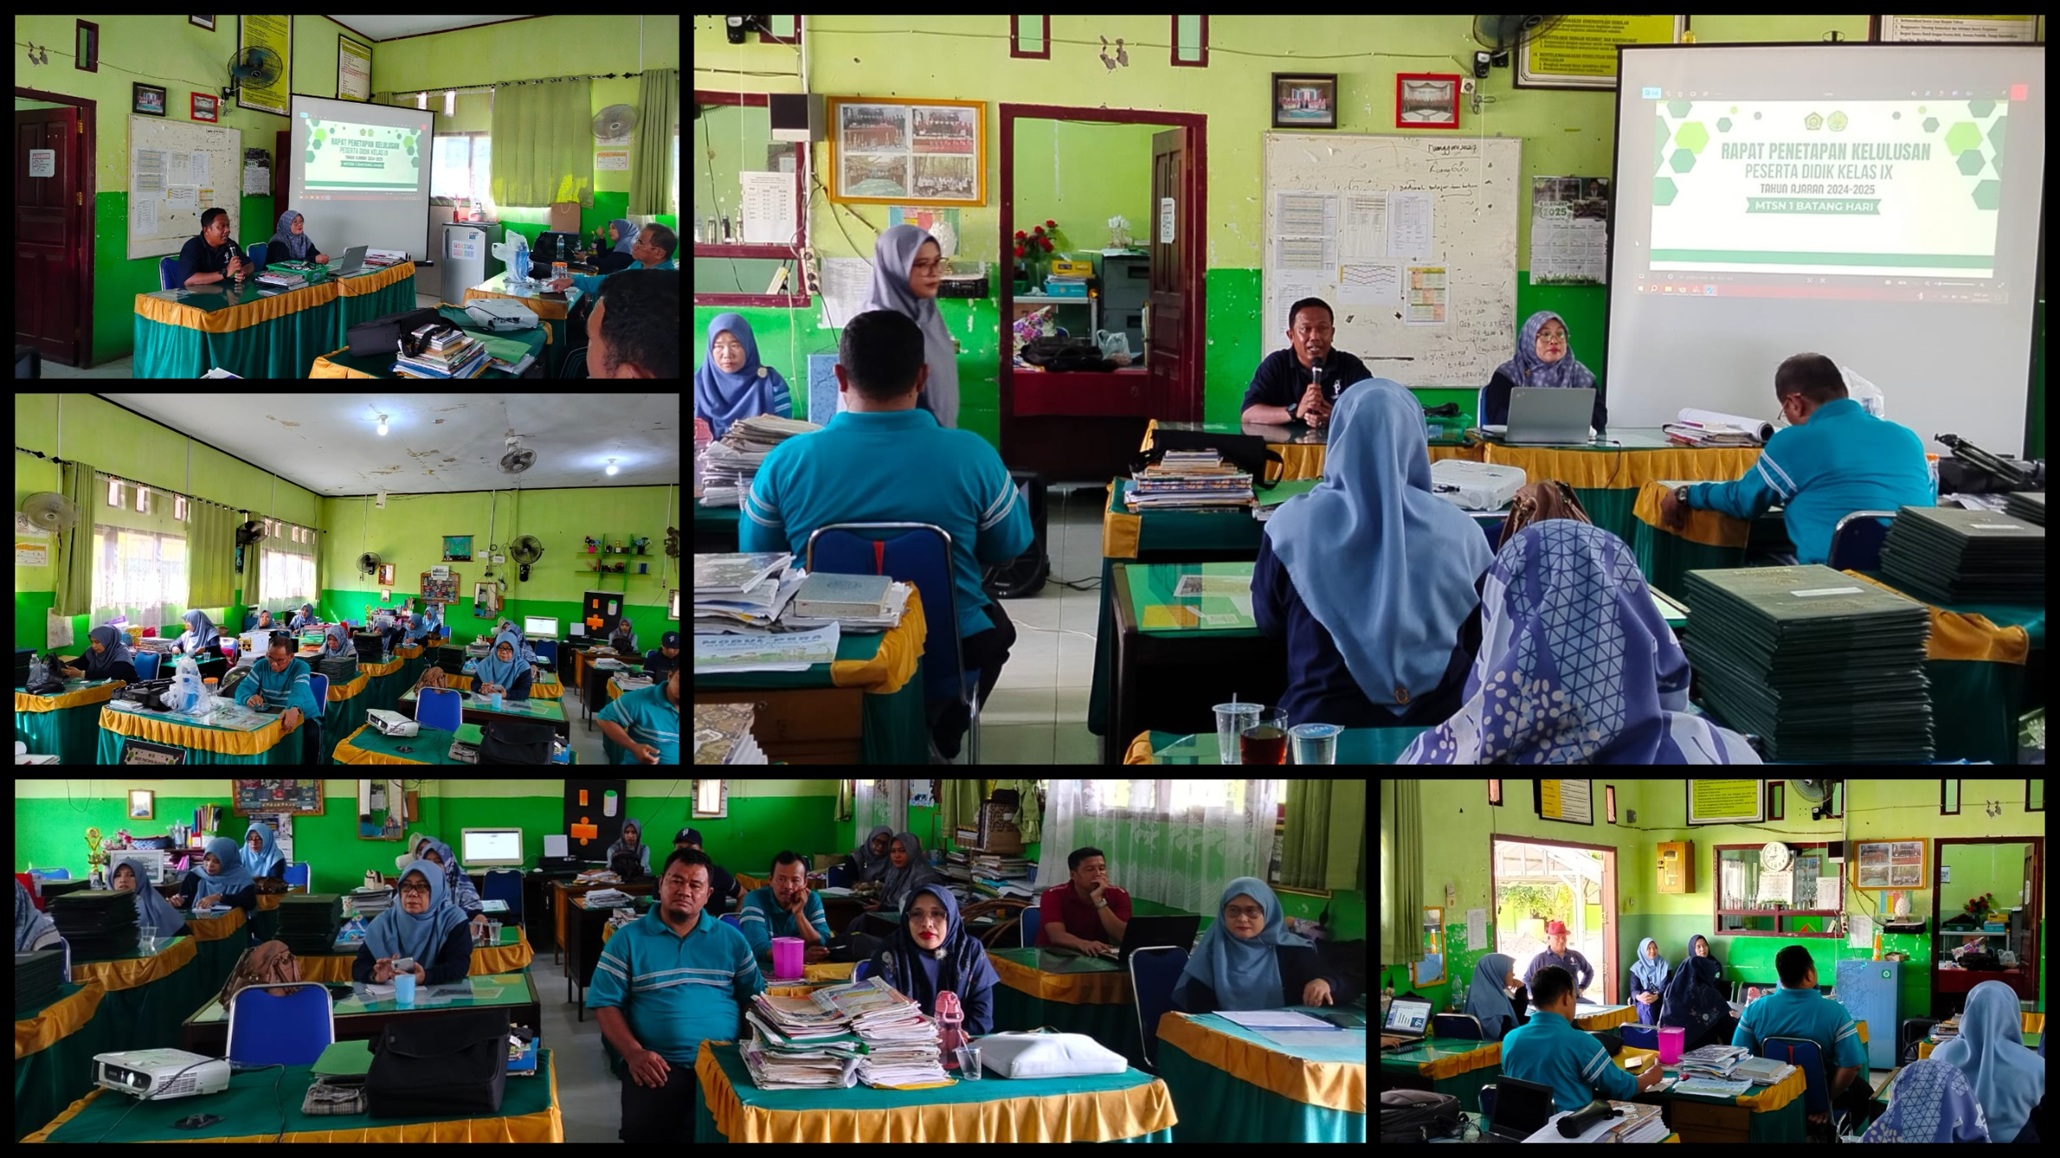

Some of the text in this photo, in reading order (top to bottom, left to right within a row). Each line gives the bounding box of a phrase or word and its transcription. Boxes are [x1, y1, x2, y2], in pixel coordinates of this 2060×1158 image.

[1721, 142, 1931, 161] RAPAT PENETAPAN KELULUSAN
[1745, 163, 1894, 180] PESERTA DIDIK KELAS IX
[1760, 183, 1876, 195] TAHUN AJARAN 2024-2025
[1796, 202, 1844, 211] BATANG
[1845, 202, 1874, 211] HARI
